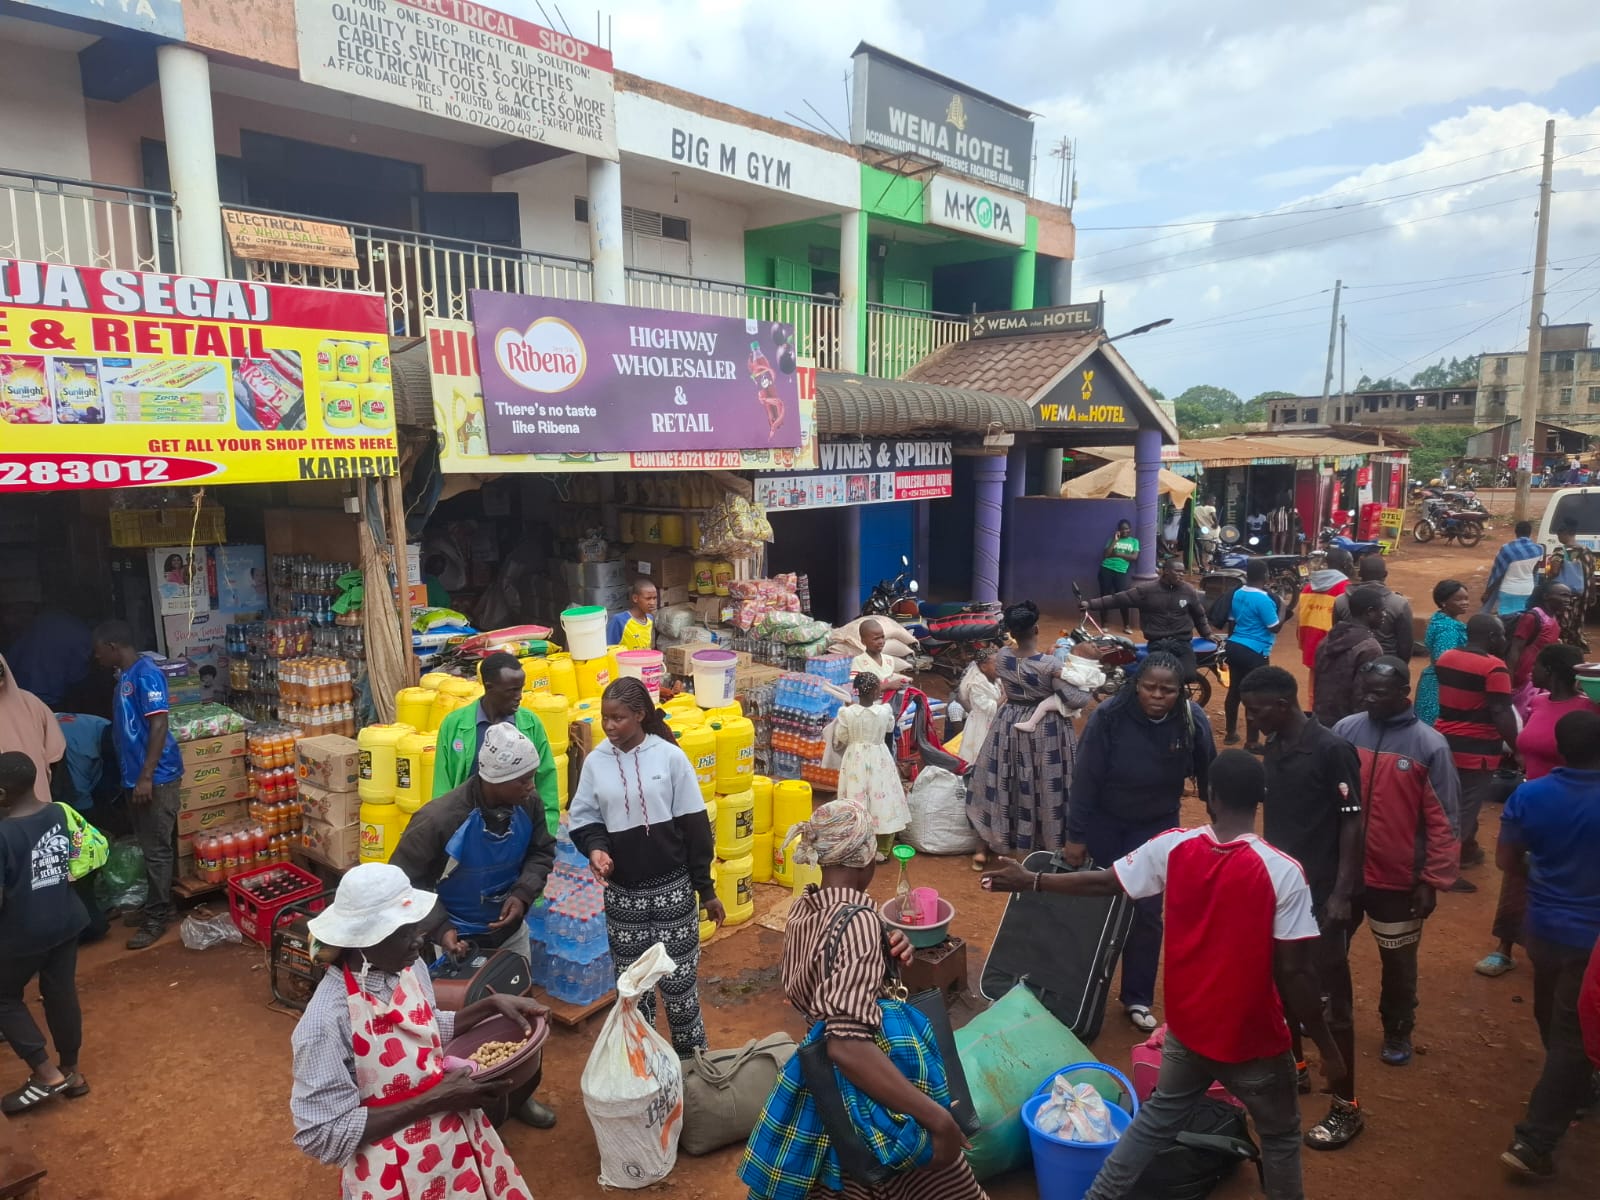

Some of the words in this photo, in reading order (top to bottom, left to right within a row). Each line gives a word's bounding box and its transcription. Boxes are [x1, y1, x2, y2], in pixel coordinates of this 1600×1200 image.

[405, 0, 519, 39] ECTRICAL
[539, 29, 590, 62] SHOP
[331, 3, 407, 41] QUALITY
[415, 29, 503, 71] ELECTRICAL
[511, 59, 574, 92] SUPPLIES
[397, 7, 459, 36] ONE-STOP
[469, 30, 529, 60] ELECTICAL
[537, 53, 591, 80] SOLUTION!
[337, 39, 432, 82] ELECTRICAL
[438, 68, 488, 98] TOOLS
[494, 86, 508, 102] &
[513, 92, 602, 130] ACCESSORIES
[493, 70, 555, 101] SOCKETS
[559, 91, 569, 106] &
[573, 94, 606, 117] MORE
[411, 78, 443, 97] PRICES
[454, 90, 493, 111] TRUSTED
[498, 100, 532, 122] BRANDS
[577, 125, 604, 142] ADVICE
[888, 105, 950, 151] WEMA
[955, 131, 1013, 172] HOTEL
[671, 127, 710, 169] BIG
[720, 142, 737, 176] M
[747, 151, 792, 190] GYM
[226, 211, 310, 234] ELECTRICAL
[944, 188, 1013, 233] M-KOPA
[254, 226, 325, 244] WHOLESALE
[987, 316, 1028, 331] WEMA
[1043, 310, 1092, 327] HOTEL
[29, 318, 77, 350] &
[91, 317, 273, 360] RETAIL
[629, 325, 718, 356] HIGHWAY
[429, 328, 481, 377] HI
[506, 339, 577, 375] Ribena
[612, 353, 737, 380] WHOLESALER
[7, 385, 44, 395] Sunlight
[63, 387, 97, 398] Sunlight
[674, 385, 688, 406] &
[495, 401, 546, 416] There's
[548, 406, 563, 416] no
[565, 404, 597, 417] taste
[1040, 403, 1077, 422] WEMA
[1089, 404, 1126, 423] HOTEL
[512, 420, 536, 434] like
[537, 420, 580, 434] Ribena
[651, 412, 714, 433] RETAIL
[149, 439, 181, 452] GET
[185, 439, 214, 452] ALL
[218, 439, 263, 452] YOUR
[266, 438, 308, 451] SHOP
[311, 438, 356, 450] ITEMS
[360, 438, 397, 450] HERE.
[820, 442, 872, 471] WINES
[876, 441, 891, 468] &
[895, 441, 953, 468] SPIRITS
[298, 455, 399, 480] KARIBU!
[704, 451, 721, 467] 827
[722, 451, 739, 467] 202
[194, 766, 221, 779] ZENTA
[202, 809, 226, 821] ZENTA
[39, 855, 60, 867] BEHIND
[40, 865, 62, 879] SCENES
